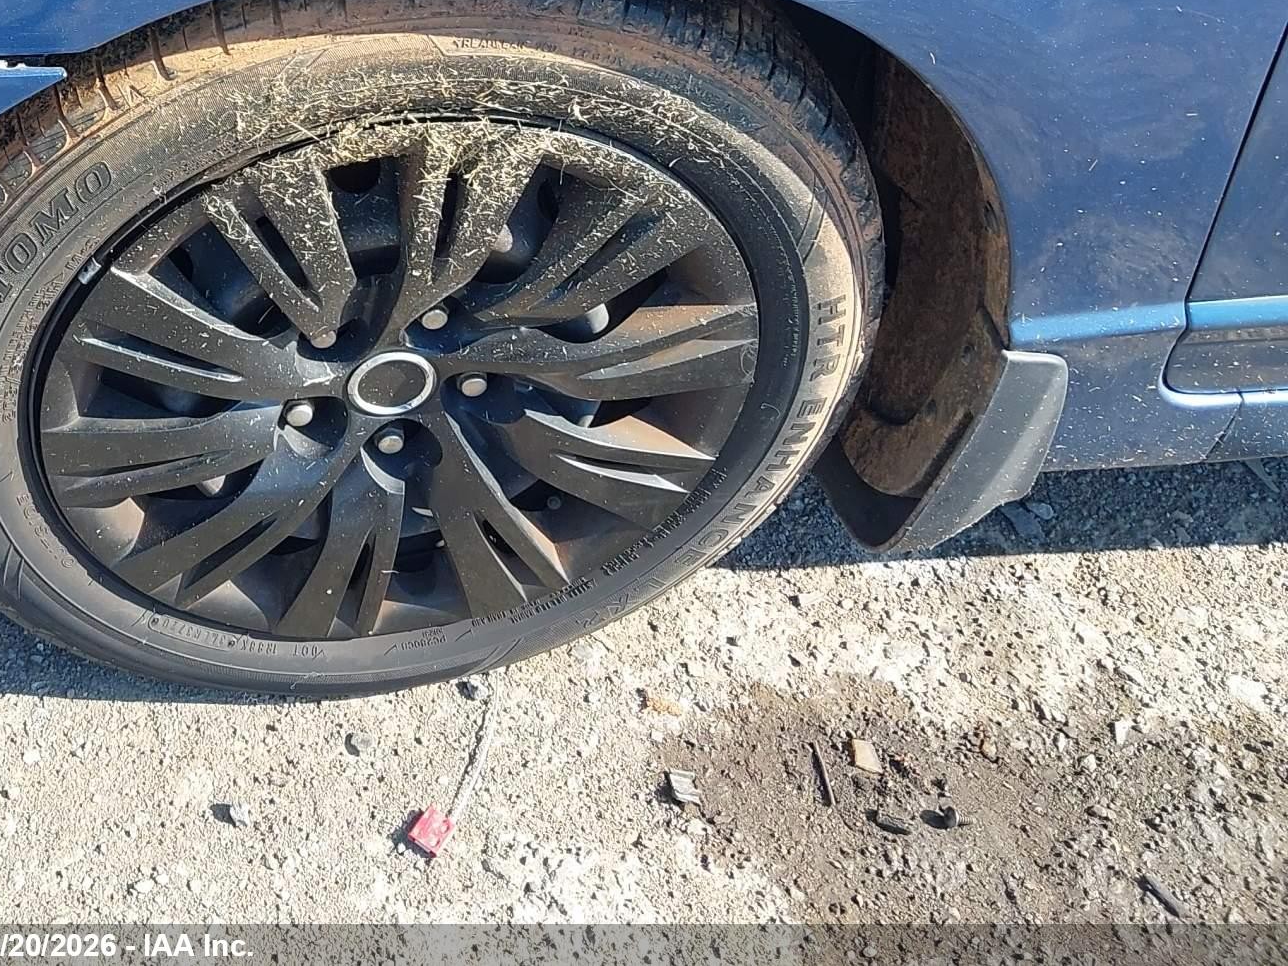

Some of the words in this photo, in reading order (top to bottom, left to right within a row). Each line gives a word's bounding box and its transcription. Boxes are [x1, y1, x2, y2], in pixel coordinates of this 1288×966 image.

[808, 293, 846, 382] HTR
[675, 395, 828, 567] ENHANCE
[292, 645, 319, 659] DOT
